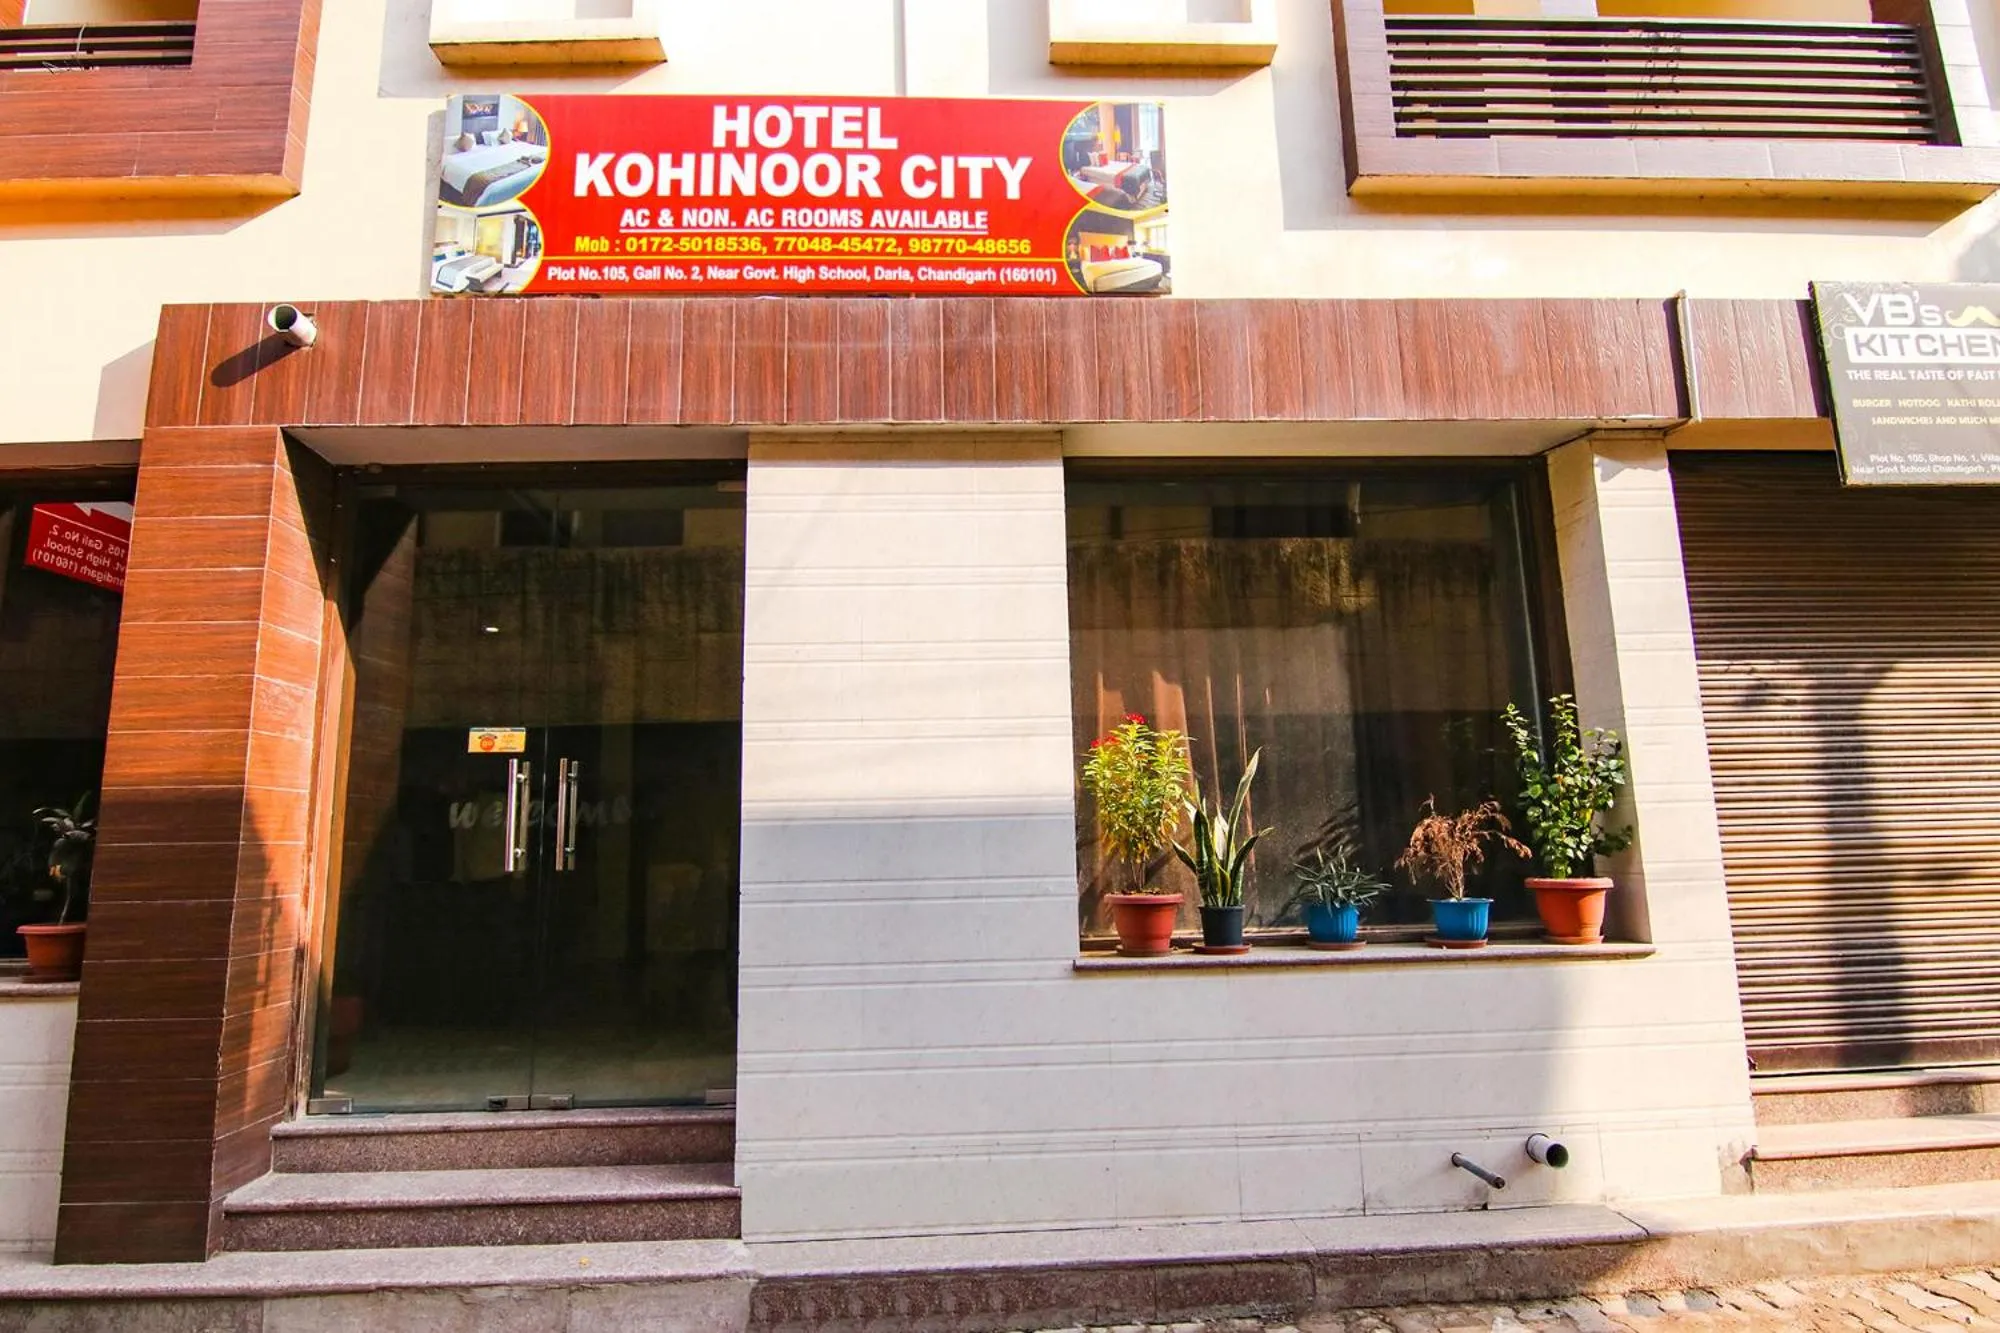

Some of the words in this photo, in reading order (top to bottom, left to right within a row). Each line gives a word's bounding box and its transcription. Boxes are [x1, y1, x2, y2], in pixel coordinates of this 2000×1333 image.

[712, 104, 899, 150] HOTEL
[574, 152, 883, 198] KOHINOOR
[900, 155, 1033, 200] CITY
[619, 208, 650, 227] AC
[657, 208, 674, 227] &
[682, 208, 737, 227] NON.
[744, 208, 774, 227] AC
[781, 208, 863, 228] ROOMS
[869, 209, 988, 229] AVAILABLE
[574, 236, 610, 253] Mob
[625, 235, 768, 254] 0172-5018536,
[773, 236, 903, 256] 77048-45472,
[908, 238, 1032, 255] 98770-48656
[547, 266, 576, 281] Plot
[632, 266, 662, 281] Gali
[663, 266, 687, 281] No.
[691, 266, 703, 282] 2,
[707, 266, 740, 281] Near
[742, 266, 779, 281] Govt.
[783, 266, 816, 283] High
[818, 266, 871, 283] School,
[874, 267, 914, 283] Daria,
[917, 267, 997, 285] Chandigarh
[999, 268, 1058, 285] (160101)
[1843, 290, 1942, 327] VB's
[1846, 370, 1872, 381] THE
[1874, 370, 1907, 381] REAL
[1908, 369, 1944, 381] TASTE
[1947, 369, 1964, 381] OF
[1967, 369, 1995, 381] FAST
[1852, 398, 1892, 408] BURGER
[1898, 398, 1941, 408] HOTDOG
[1946, 398, 1976, 408] KATHI
[1871, 416, 1933, 426] SANDWICHES
[1935, 416, 1957, 425] AND
[1959, 416, 1987, 426] MUCH
[449, 797, 633, 830] wecme
